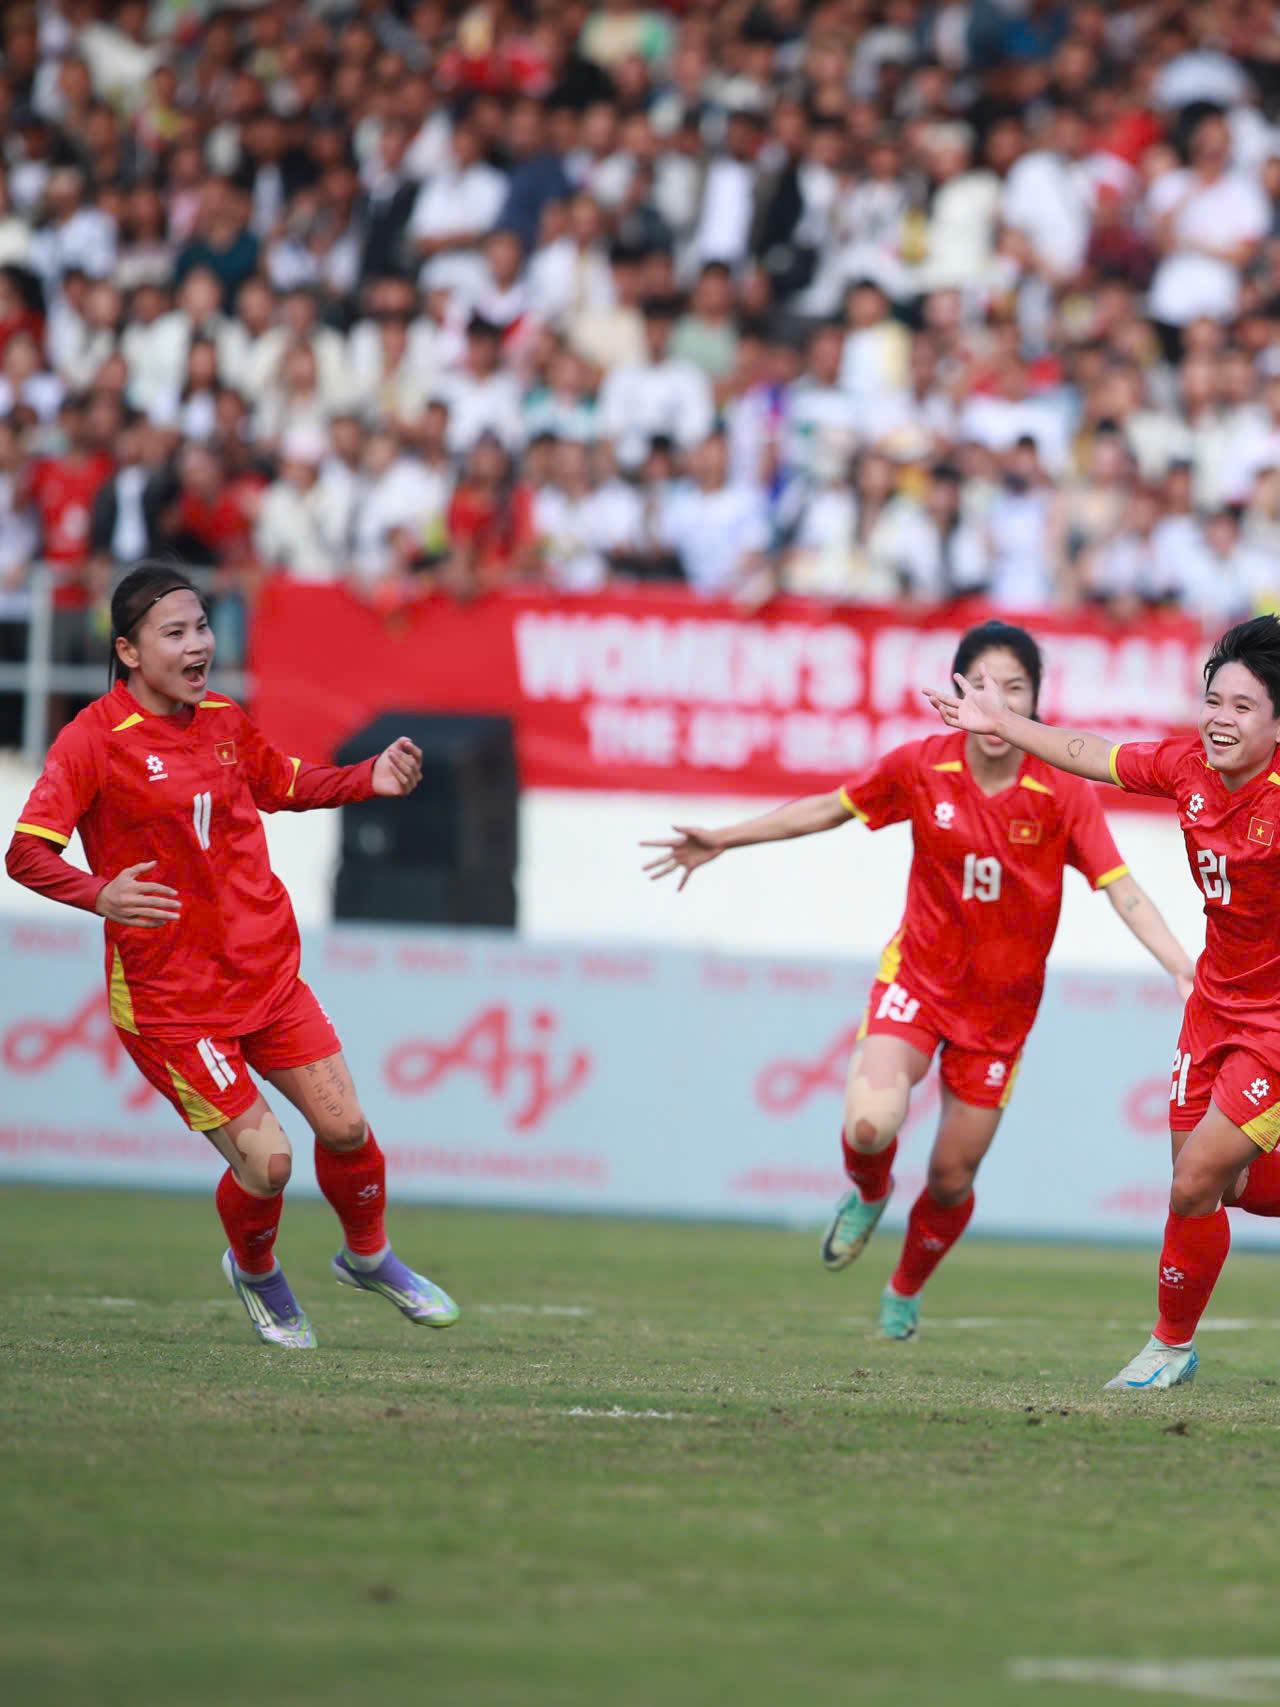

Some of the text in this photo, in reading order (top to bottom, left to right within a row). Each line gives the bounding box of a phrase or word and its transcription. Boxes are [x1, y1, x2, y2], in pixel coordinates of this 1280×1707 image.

[193, 791, 212, 850] 11
[962, 853, 1002, 902] 19
[1197, 849, 1231, 905] 21
